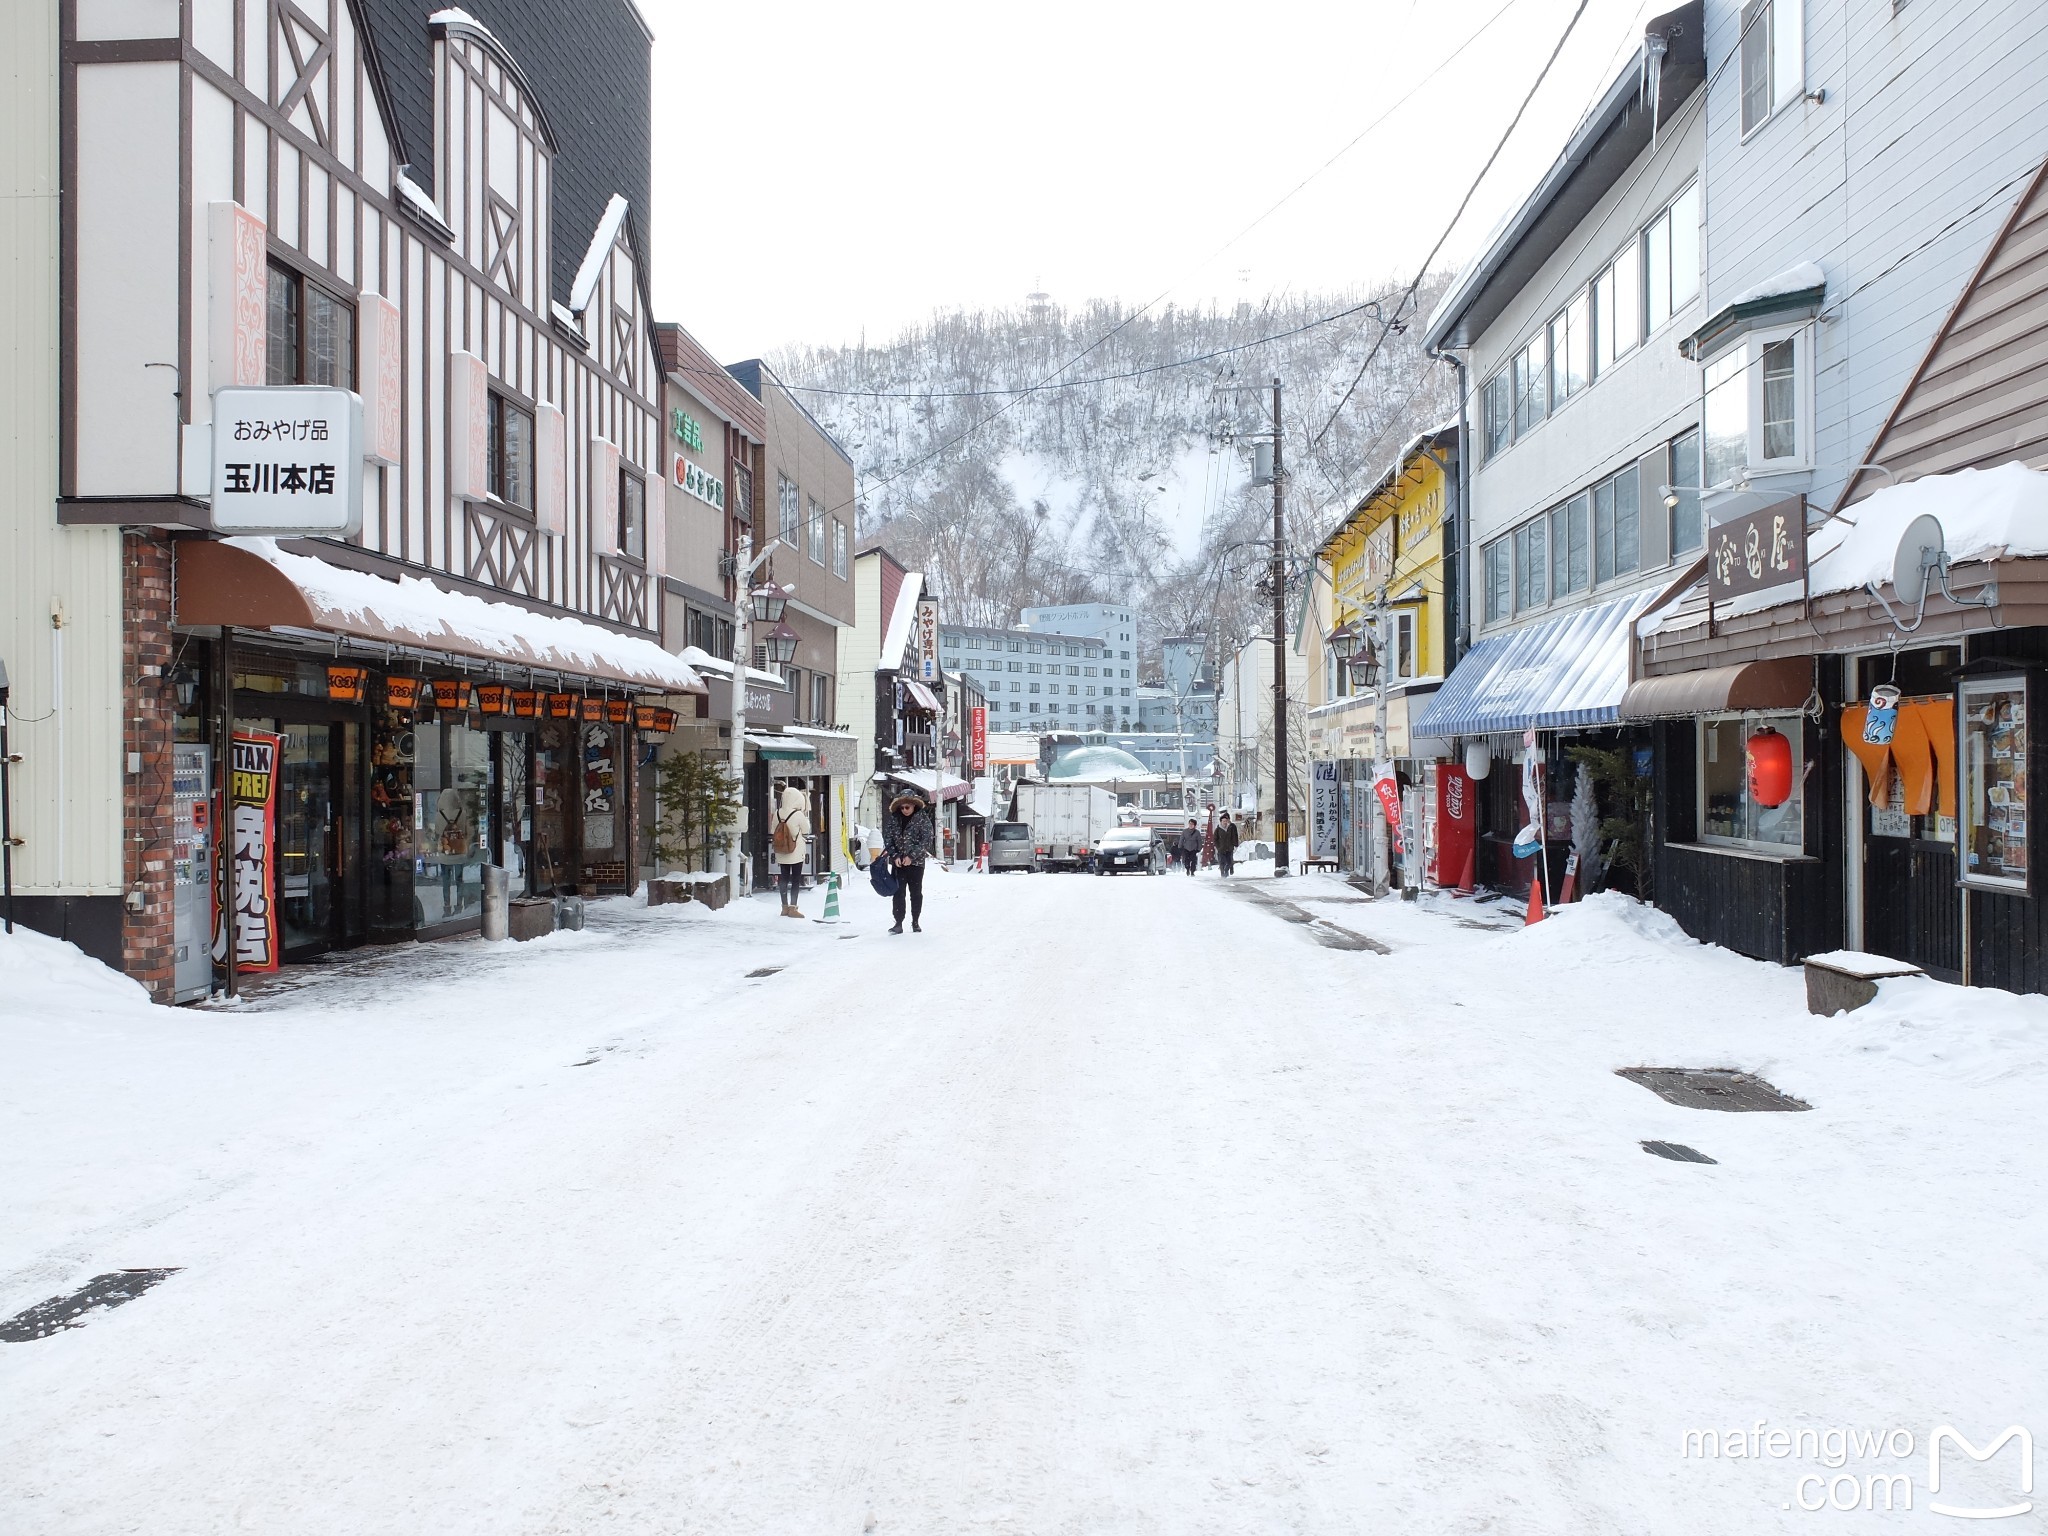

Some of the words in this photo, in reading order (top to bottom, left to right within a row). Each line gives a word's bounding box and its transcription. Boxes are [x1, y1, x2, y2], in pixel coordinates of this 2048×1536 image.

[234, 419, 329, 441] おみやげ品
[224, 463, 335, 494] 玉川本店
[1734, 556, 1741, 566] TO
[921, 606, 934, 660] みやげ専門
[233, 745, 270, 771] TAX
